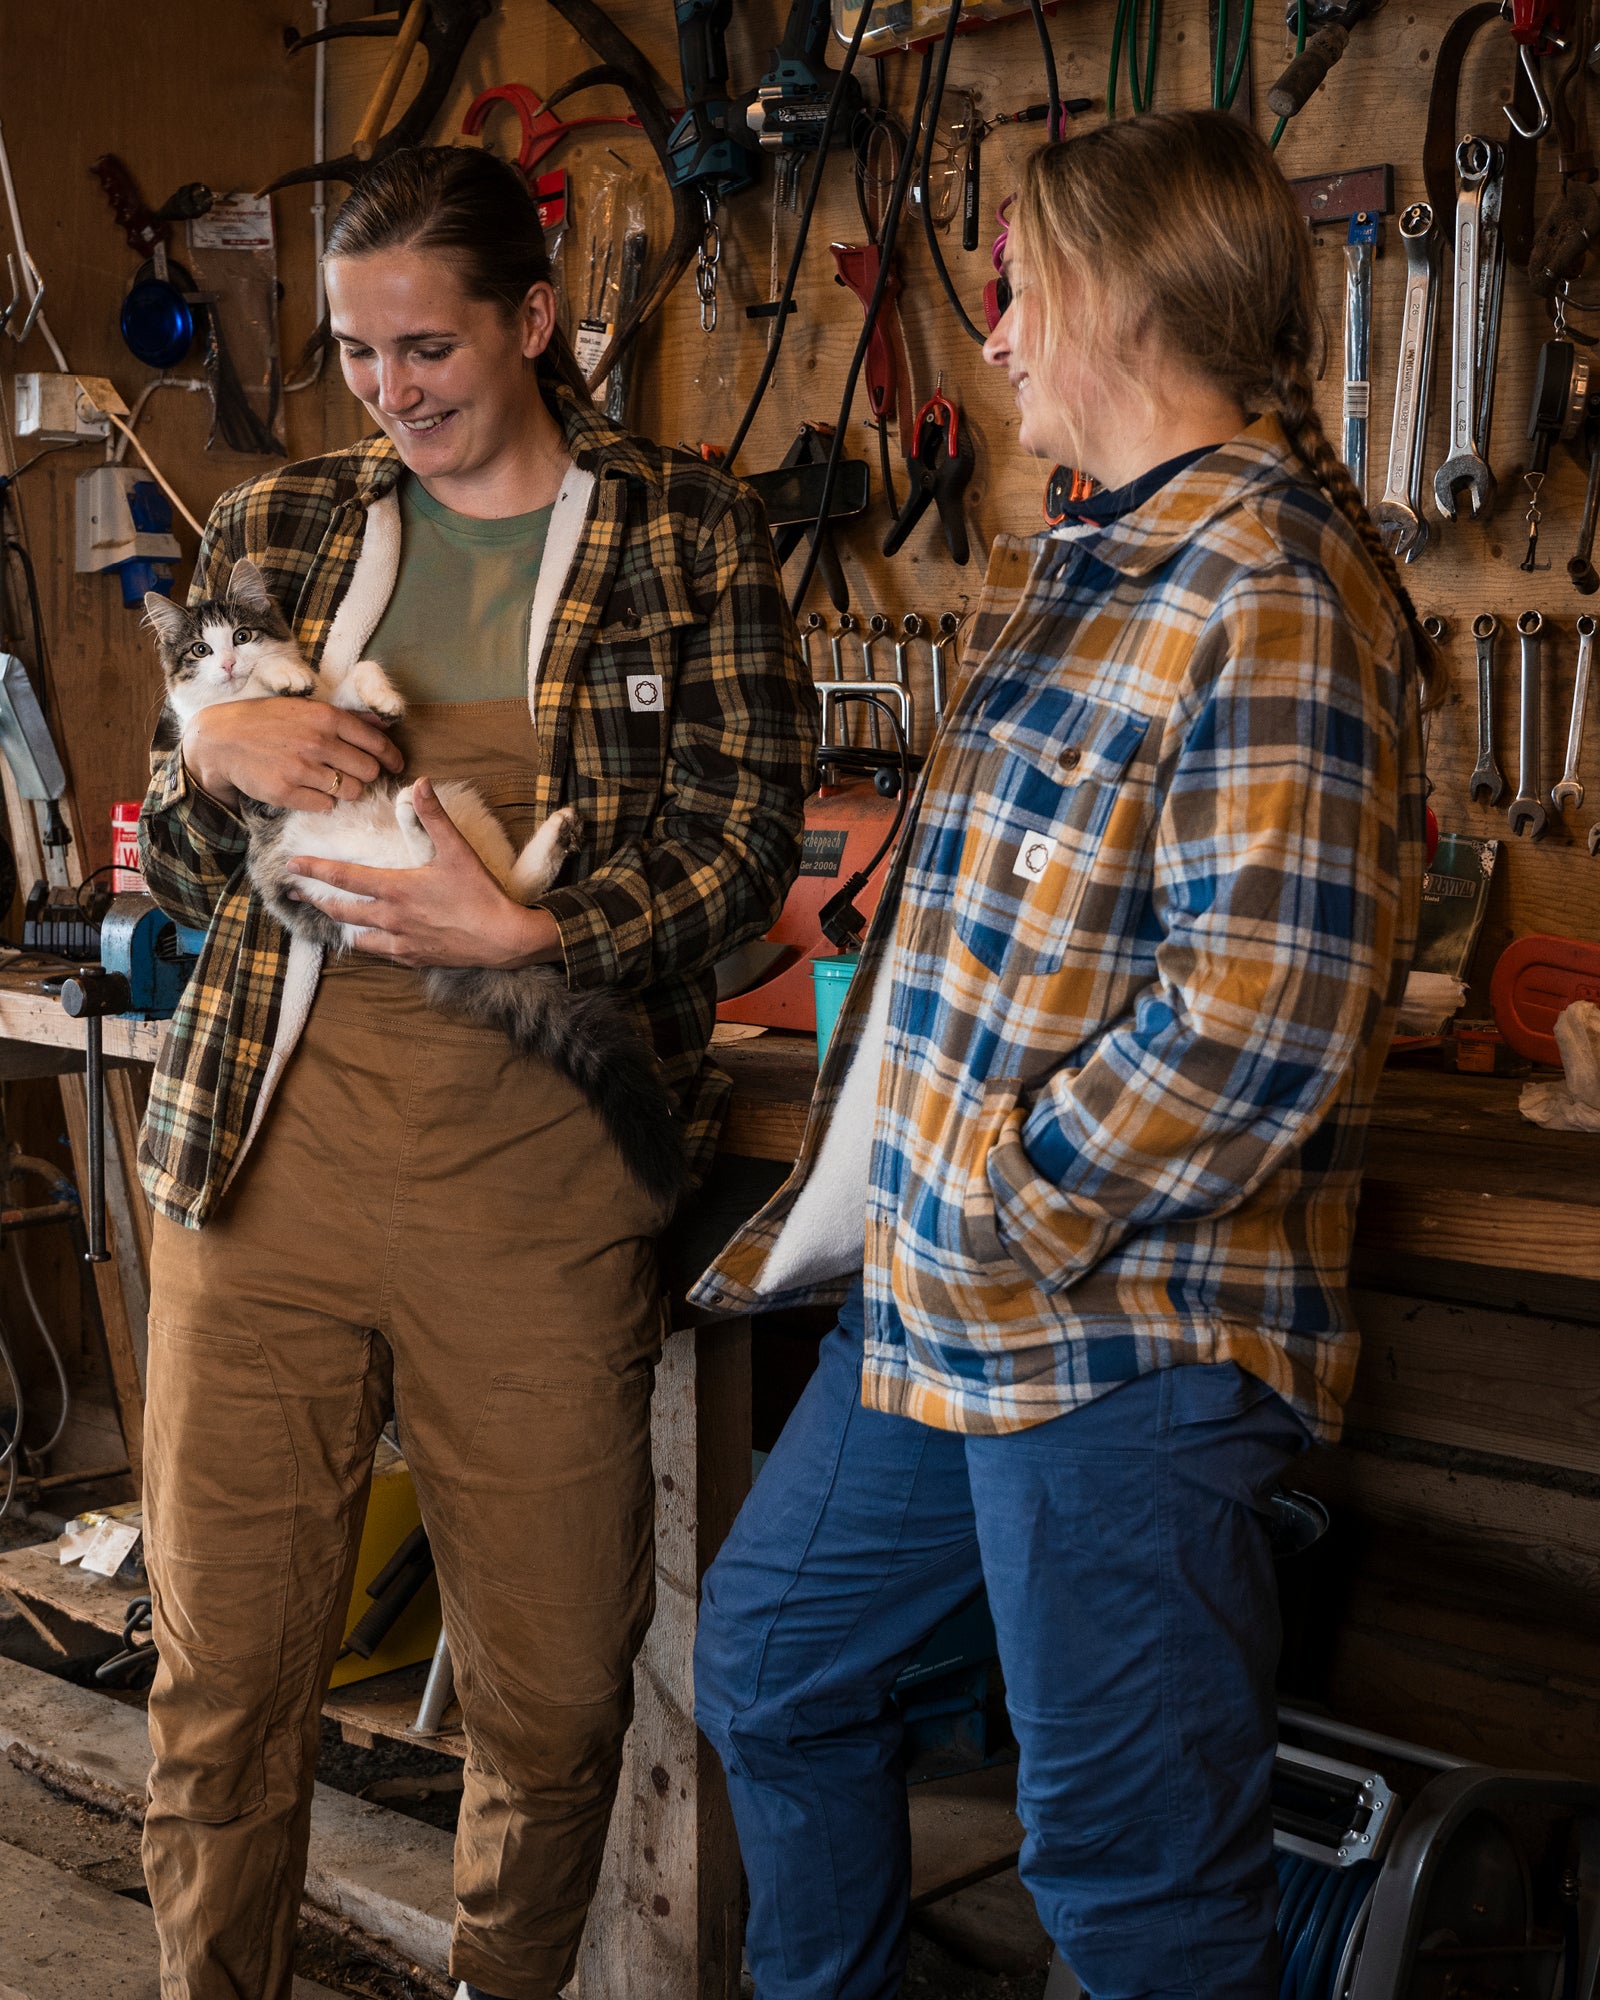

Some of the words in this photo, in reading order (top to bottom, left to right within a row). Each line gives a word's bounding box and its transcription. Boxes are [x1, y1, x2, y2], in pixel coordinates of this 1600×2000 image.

[1412, 303, 1420, 316] 26
[1395, 465, 1403, 478] 26
[803, 830, 841, 853] cheppach
[800, 860, 812, 870] Ger
[813, 861, 838, 871] 2000s
